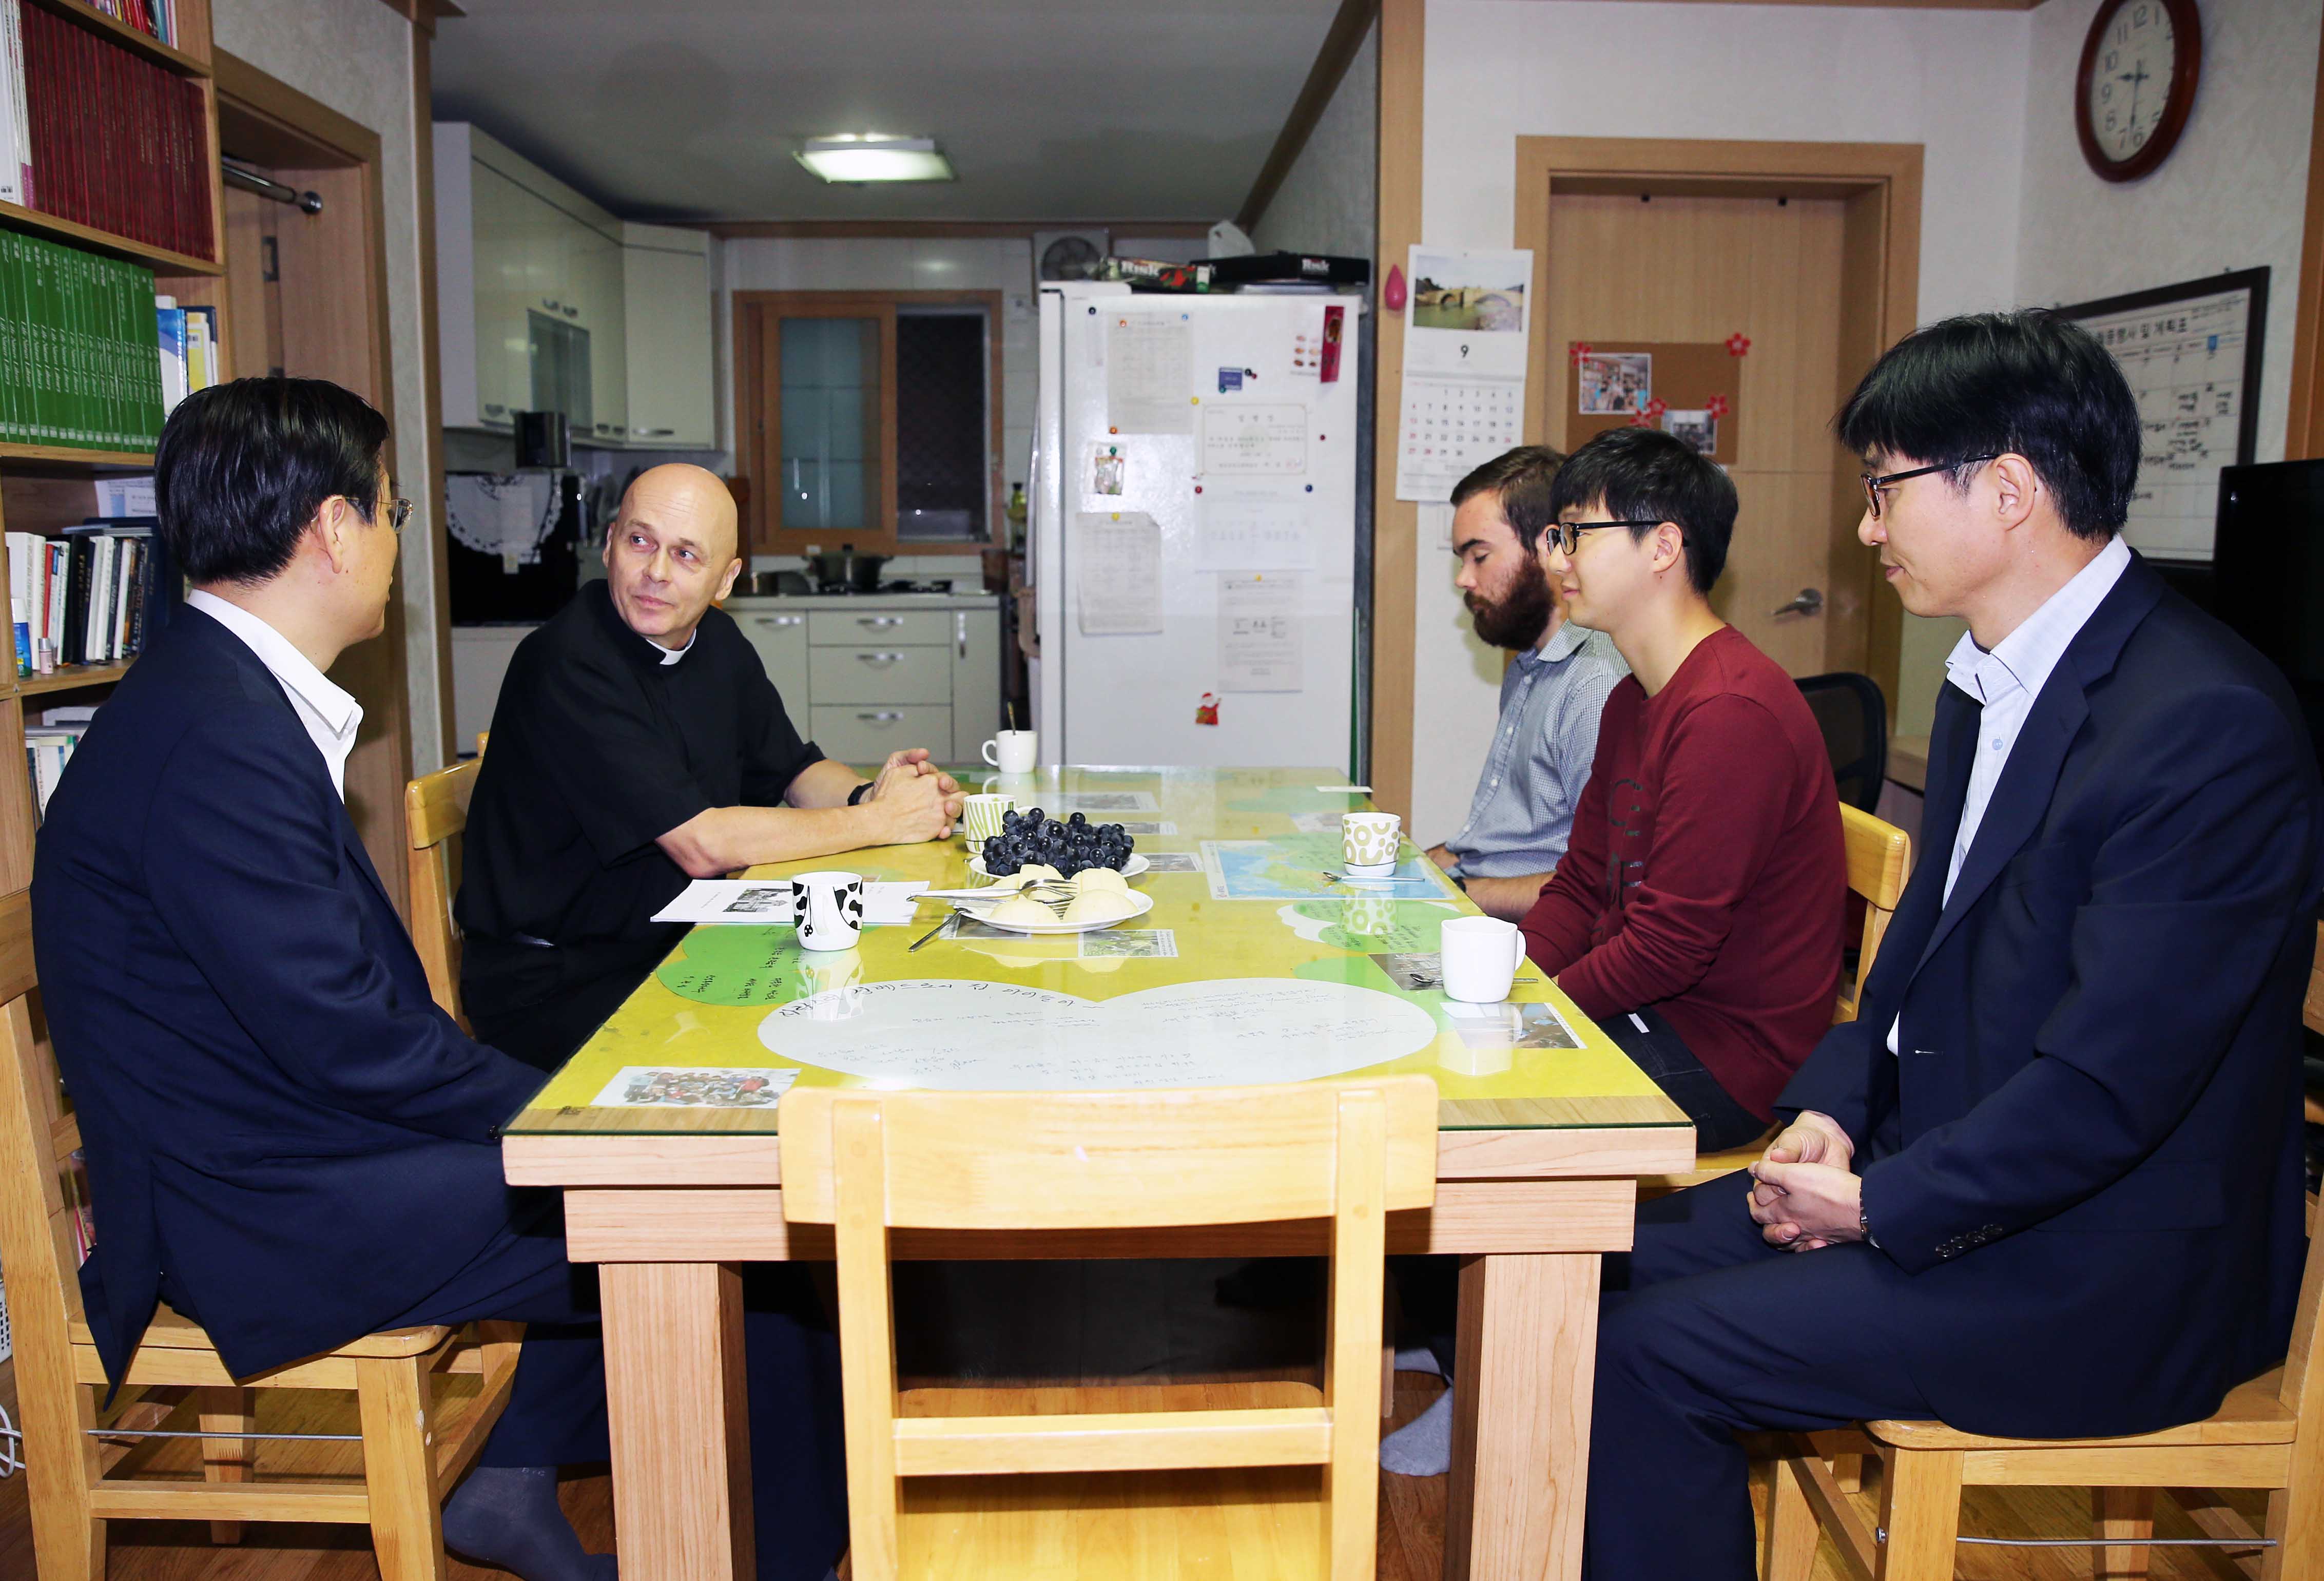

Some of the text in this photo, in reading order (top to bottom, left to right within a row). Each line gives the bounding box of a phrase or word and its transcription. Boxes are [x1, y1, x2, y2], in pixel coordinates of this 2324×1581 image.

[2134, 5, 2147, 28] 12
[2117, 24, 2127, 44] 11
[2105, 50, 2118, 72] 10
[2102, 83, 2112, 103] 9
[2105, 108, 2116, 131] 8
[2119, 127, 2127, 149] 7
[1461, 345, 1469, 358] 9
